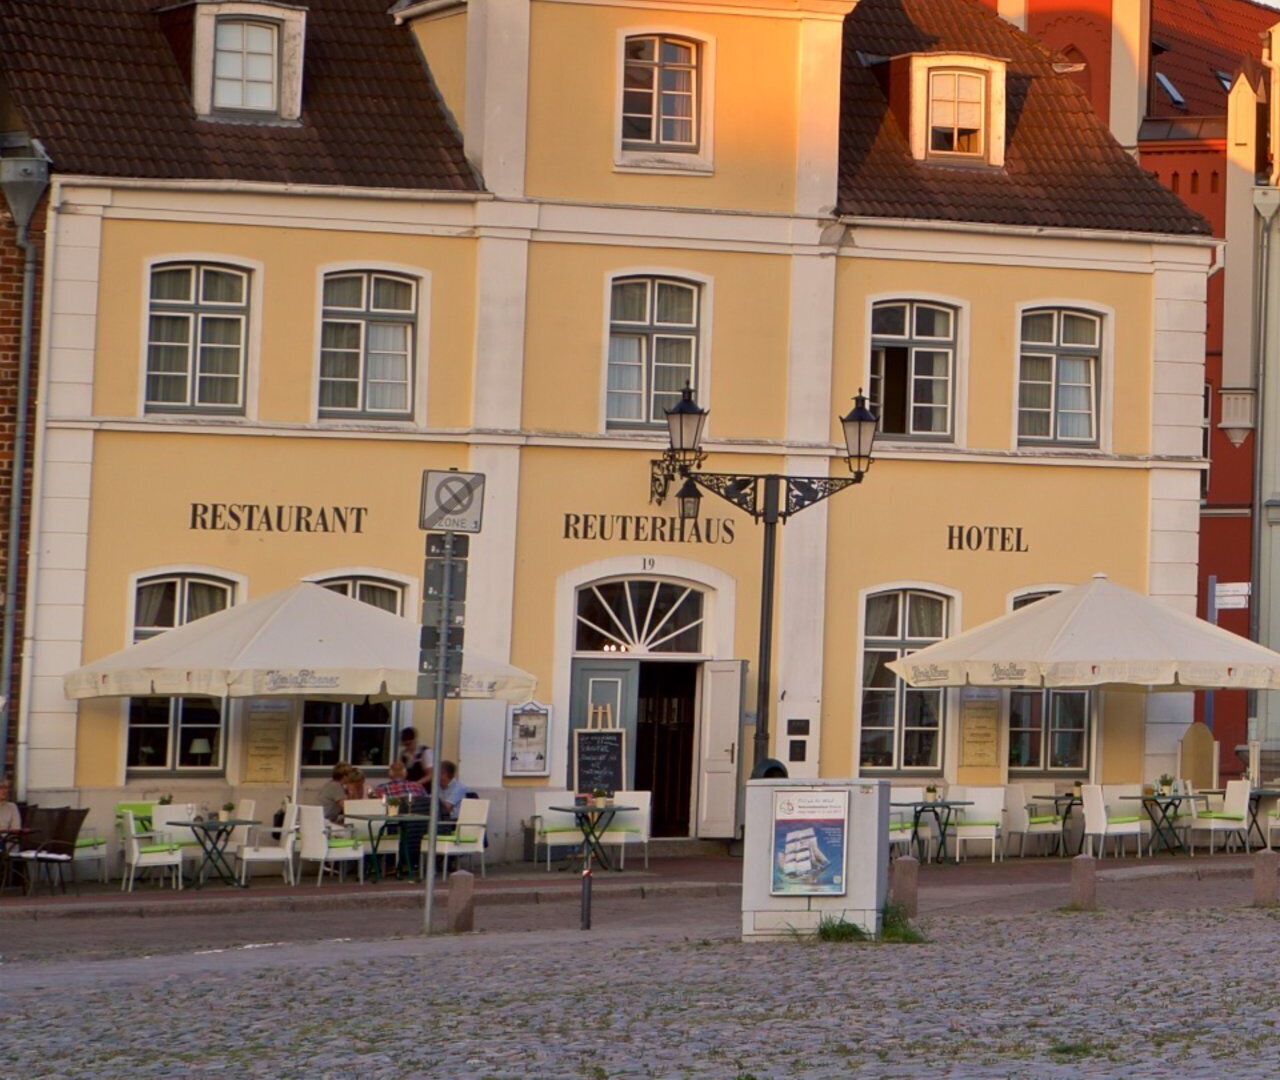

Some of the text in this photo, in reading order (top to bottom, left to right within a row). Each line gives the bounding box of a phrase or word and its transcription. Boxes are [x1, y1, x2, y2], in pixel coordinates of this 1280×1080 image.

[189, 503, 368, 533] RESTAURANT
[437, 518, 467, 528] ZONE
[562, 513, 735, 544] REUTERHAUS
[947, 525, 1029, 552] HOTEL
[641, 557, 655, 570] 19
